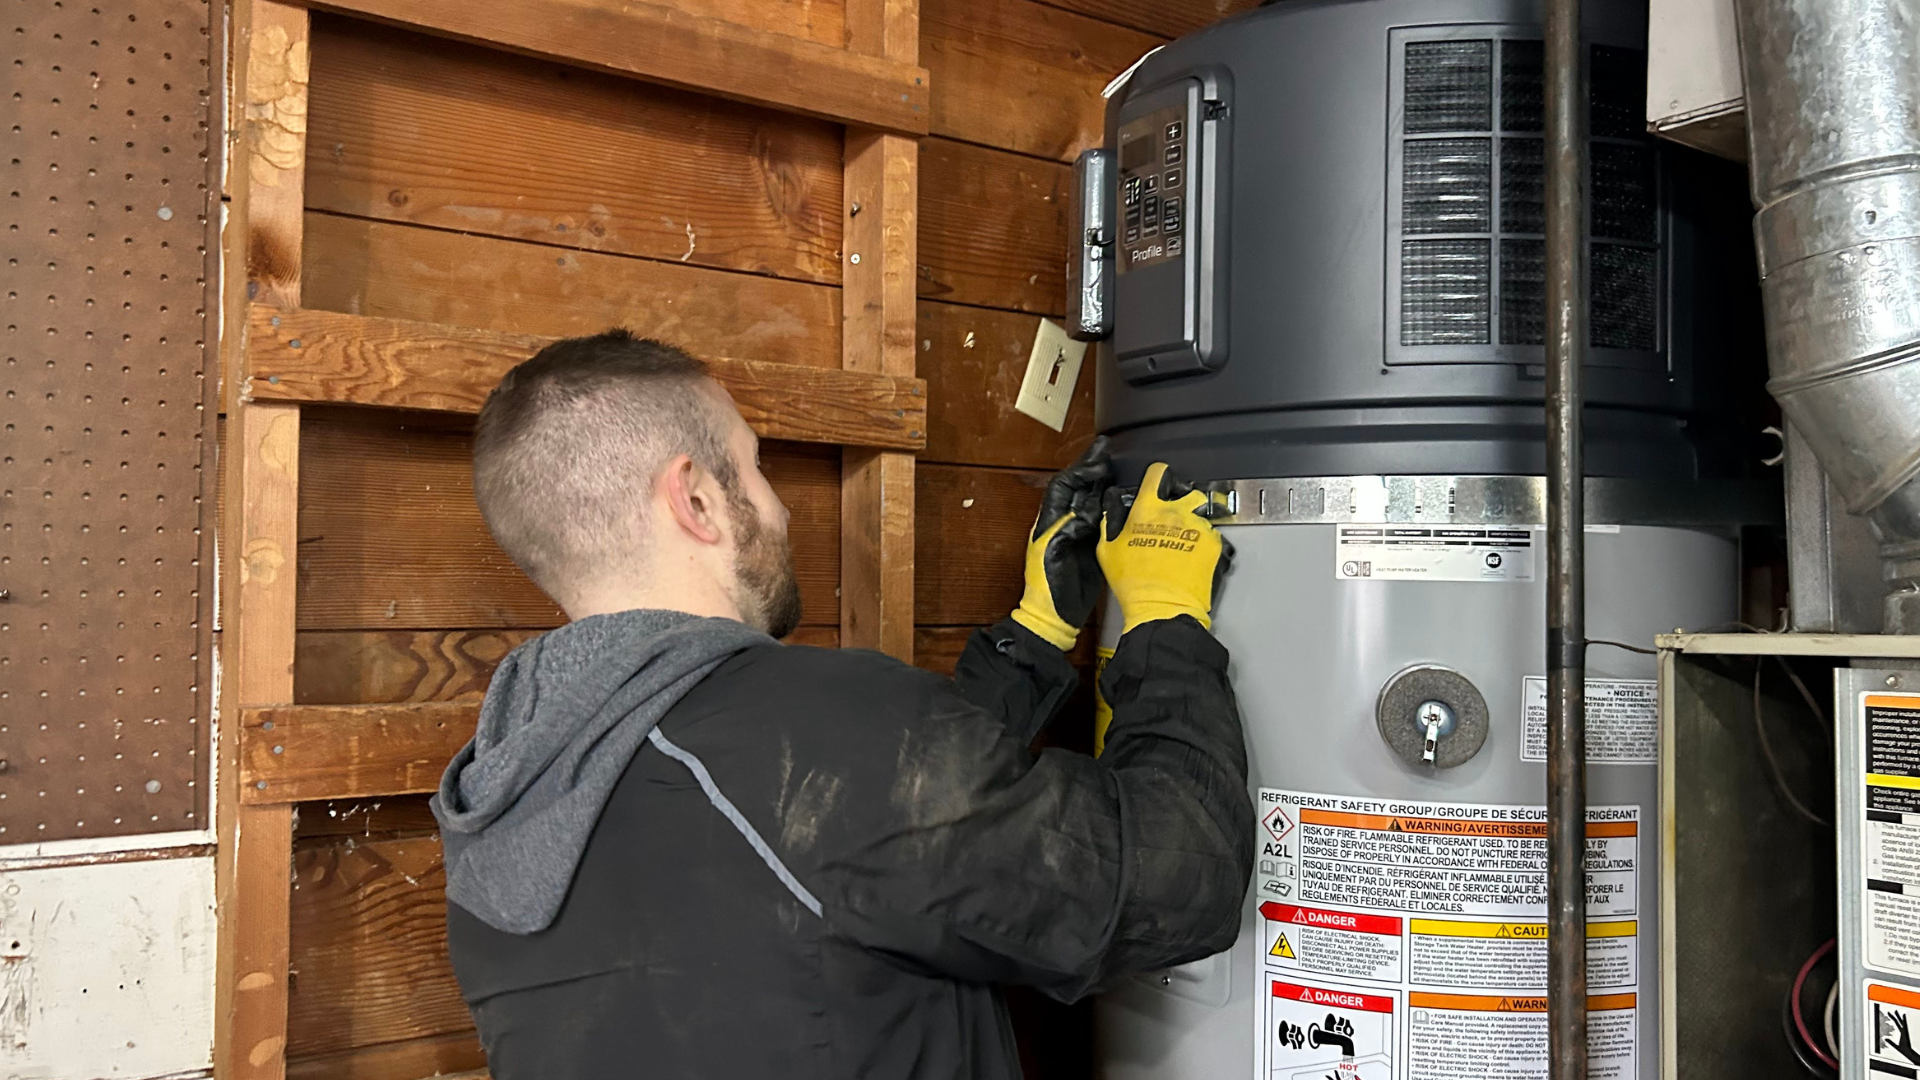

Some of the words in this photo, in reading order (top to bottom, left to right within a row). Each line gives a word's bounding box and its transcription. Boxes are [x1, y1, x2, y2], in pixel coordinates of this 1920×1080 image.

[1132, 246, 1162, 262] Profile
[1128, 538, 1158, 548] GRIP
[1159, 539, 1194, 552] FIRM
[1487, 556, 1499, 565] NSF
[1346, 564, 1354, 573] UL
[1261, 792, 1338, 809] REFRIGERANT
[1340, 800, 1386, 812] SAFETY
[1389, 804, 1488, 818] GROUP/GROUPE
[1492, 809, 1507, 819] DE
[1510, 808, 1547, 820] SÉCUR
[1405, 820, 1547, 835] WARNING/AVERTISSEME
[1303, 826, 1322, 836] RISK
[1324, 828, 1336, 837] OF
[1337, 829, 1358, 840] FIRE.
[1360, 831, 1414, 844] FLAMMABLE
[1416, 836, 1478, 847] REFRIGERANT
[1480, 838, 1505, 848] USED.
[1507, 840, 1518, 848] TO
[1520, 840, 1532, 849] BE
[1598, 840, 1608, 849] BY
[1263, 842, 1292, 859] A2L
[1302, 836, 1338, 847] TRAINED
[1340, 840, 1377, 851] SERVICE
[1379, 844, 1434, 855] PERSONNEL.
[1436, 846, 1449, 856] DO
[1452, 848, 1469, 857] NOT
[1471, 849, 1518, 859] PUNCTURE
[1303, 846, 1338, 858] DISPOSE
[1340, 850, 1352, 859] OF
[1354, 852, 1400, 863] PROPERLY
[1402, 855, 1410, 864] IN
[1413, 856, 1475, 867] ACCORDANCE
[1477, 860, 1498, 868] WITH
[1500, 860, 1539, 869] FEDERAL
[1303, 860, 1333, 873] RISQUE
[1387, 866, 1449, 881] RÉFRIGÉRANT
[1451, 872, 1512, 883] INFLAMMABLE
[1302, 870, 1357, 884] UNIQUEMENT
[1359, 876, 1377, 886] PAR
[1378, 878, 1391, 887] DU
[1393, 880, 1446, 891] PERSONNEL
[1449, 882, 1460, 892] DE
[1462, 884, 1499, 893] SERVICE
[1615, 884, 1624, 893] LE
[1302, 879, 1330, 891] TUYAU
[1332, 884, 1343, 892] DE
[1594, 895, 1610, 904] AUX
[1409, 900, 1420, 909] ET
[1421, 901, 1464, 912] LOCALES.
[1308, 912, 1356, 927] DANGER
[1324, 931, 1358, 940] ELECTRICAL
[1513, 926, 1547, 936] CAUT
[1302, 939, 1336, 949] DISCONNECT
[1302, 945, 1323, 953] BEFORE
[1325, 948, 1354, 956] SERVICING
[1365, 953, 1397, 961] RESETTING
[1302, 963, 1334, 972] PERSONNEL
[1317, 959, 1345, 967] PROPERLY
[1347, 963, 1376, 971] QUALIFIED
[1315, 992, 1363, 1007] DANGER
[1512, 1000, 1547, 1009] WARN
[1339, 1063, 1358, 1072] HOT
